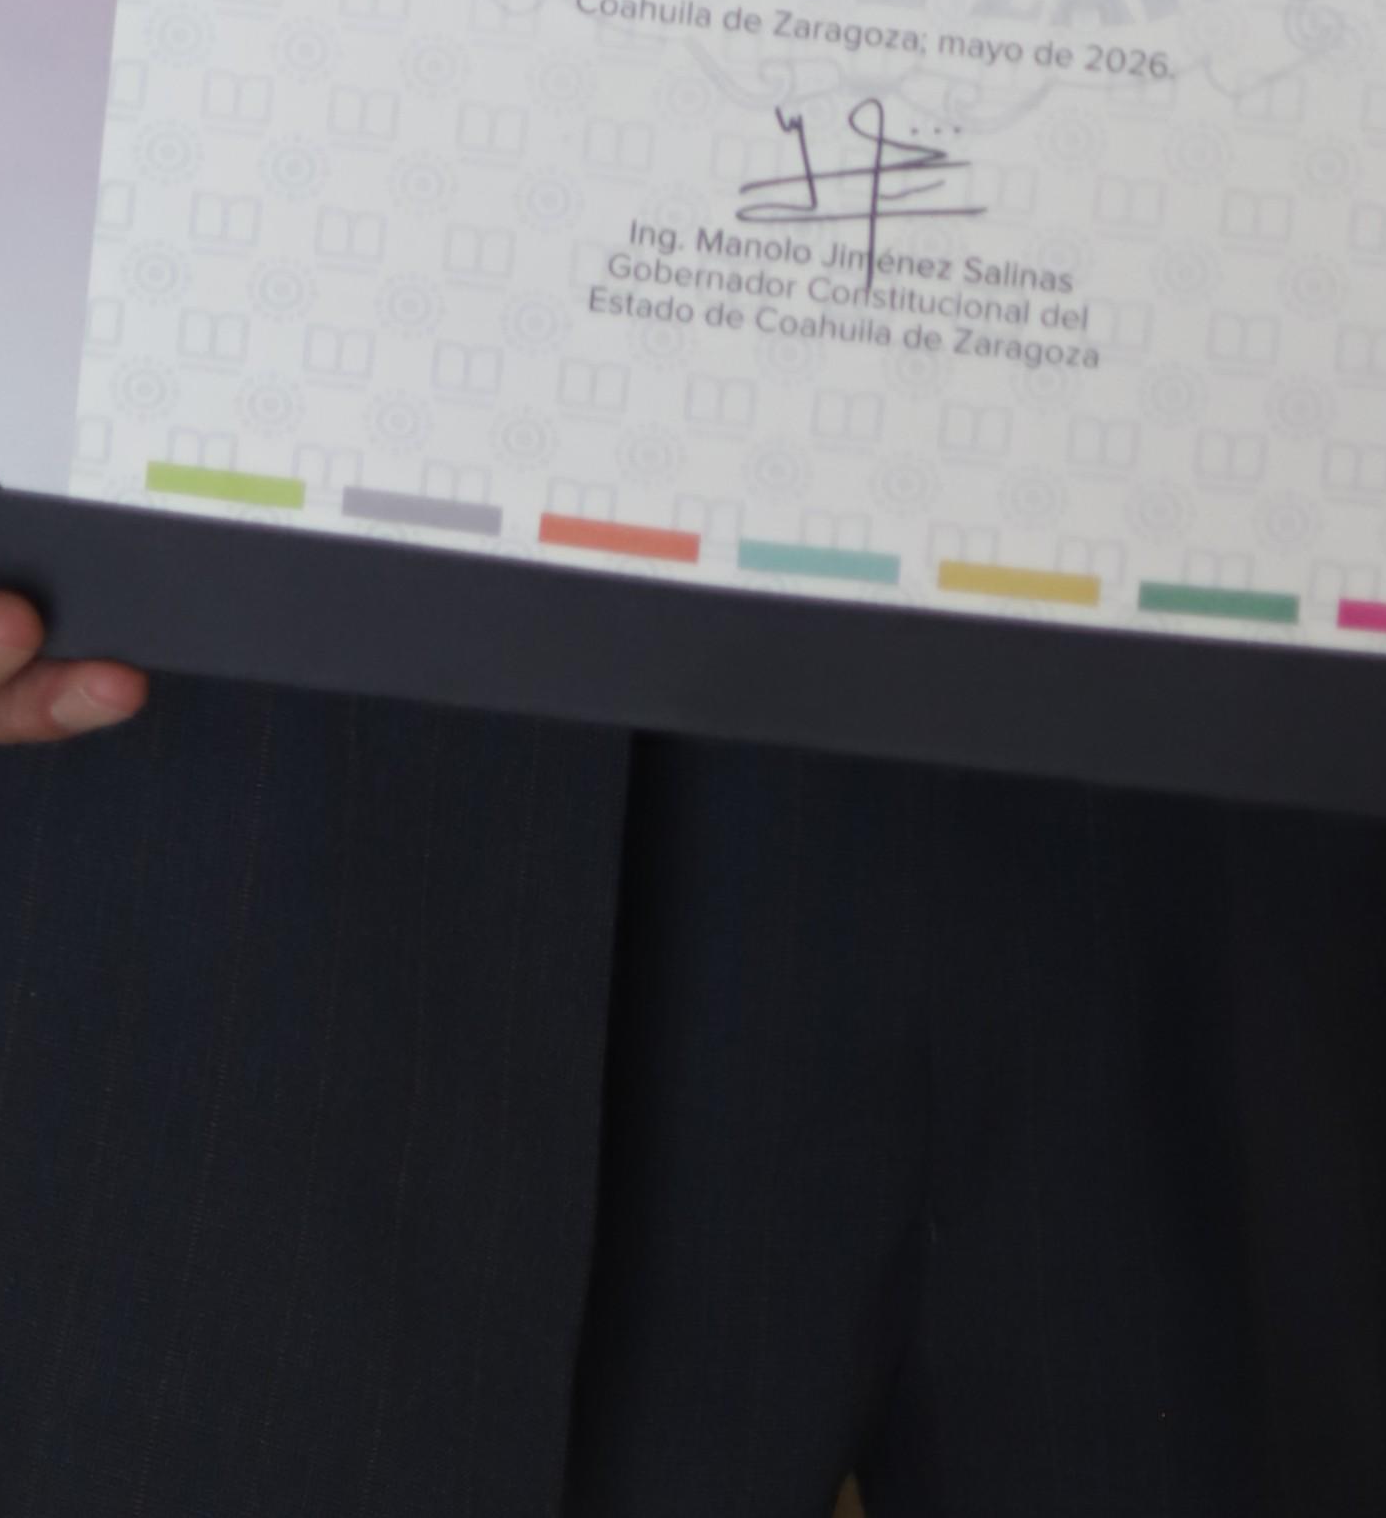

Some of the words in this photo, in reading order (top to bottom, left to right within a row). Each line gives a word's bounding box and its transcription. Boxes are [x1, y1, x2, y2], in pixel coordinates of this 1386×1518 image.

[722, 6, 763, 35] de
[938, 34, 1024, 67] mayo
[1033, 40, 1074, 69] de
[1084, 44, 1177, 82] 2026.
[607, 252, 795, 298] Gobernador
[808, 277, 1030, 325] Constitucional
[1040, 303, 1089, 332] del
[629, 219, 683, 256] Ing.
[696, 227, 812, 265] Manolo
[821, 243, 953, 280] Jiménez
[963, 256, 1074, 294] Salinas
[588, 285, 695, 324] Estado
[704, 302, 745, 330] de
[754, 306, 892, 347] Coahuila
[902, 324, 943, 352] de
[952, 326, 1101, 370] Zaragoza
